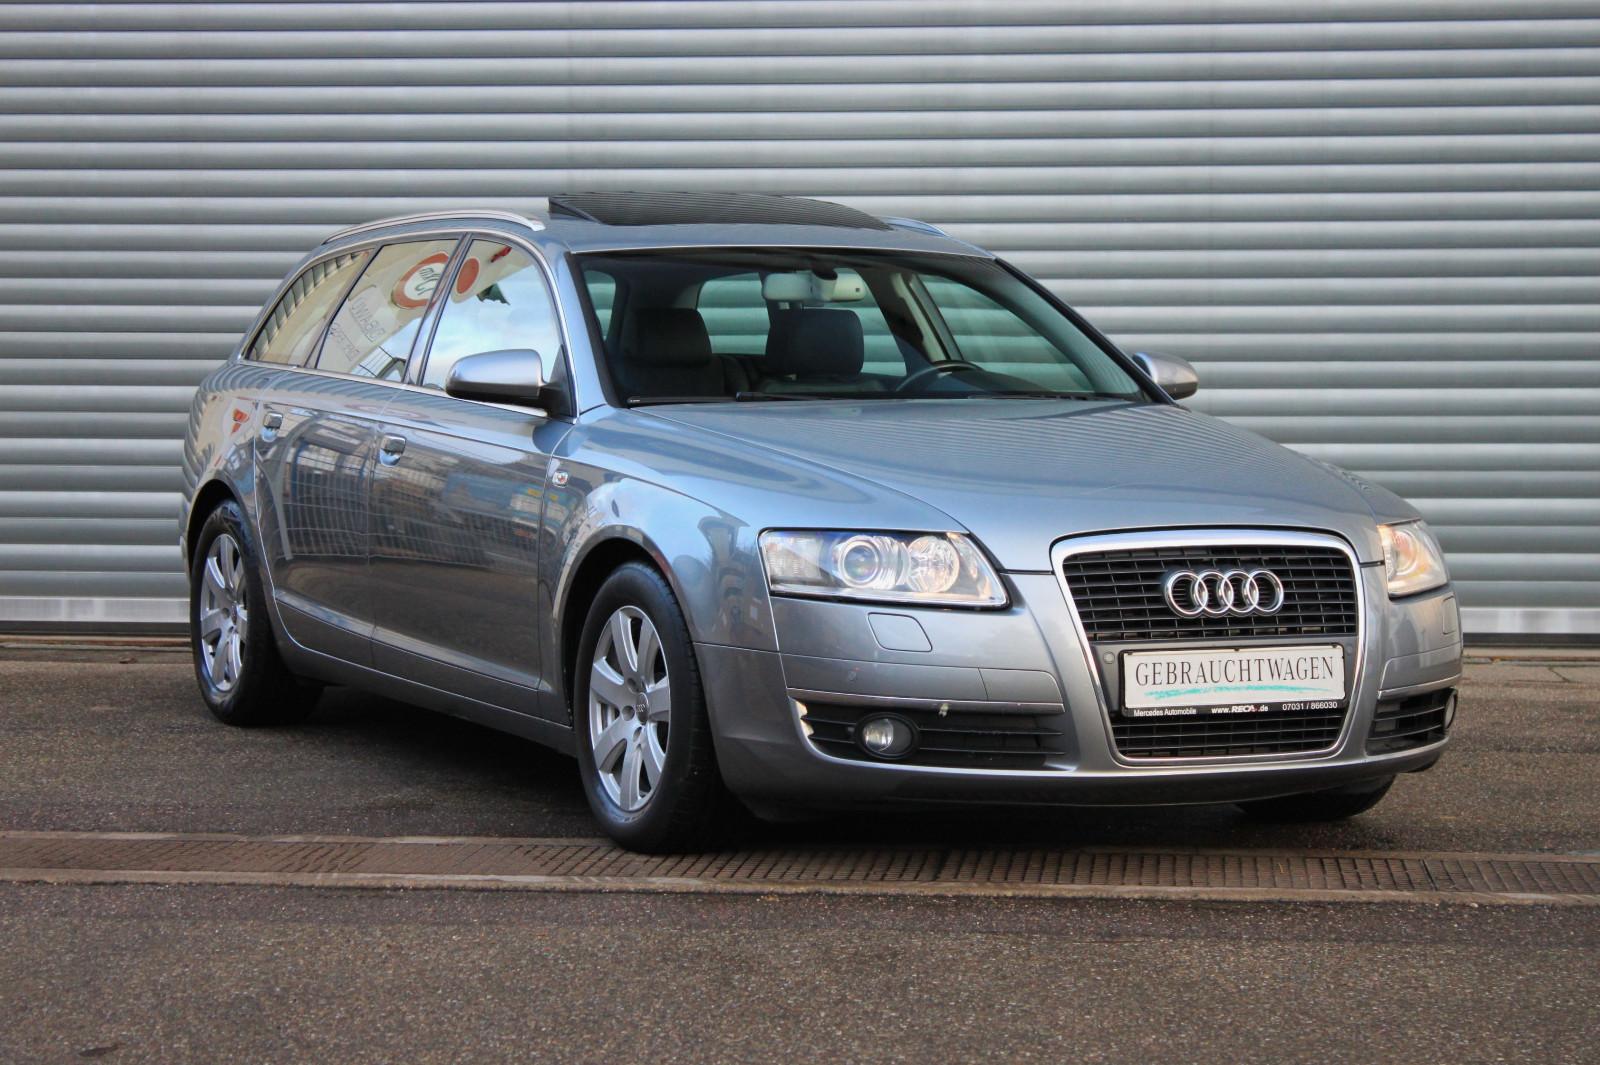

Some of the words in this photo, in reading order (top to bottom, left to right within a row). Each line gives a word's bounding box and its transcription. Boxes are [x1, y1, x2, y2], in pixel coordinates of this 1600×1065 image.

[1136, 656, 1335, 687] GEBRAUCHTWAGEN
[1133, 708, 1163, 717] Mercedes
[1164, 707, 1197, 716] Automobile
[1282, 702, 1304, 710] 07031
